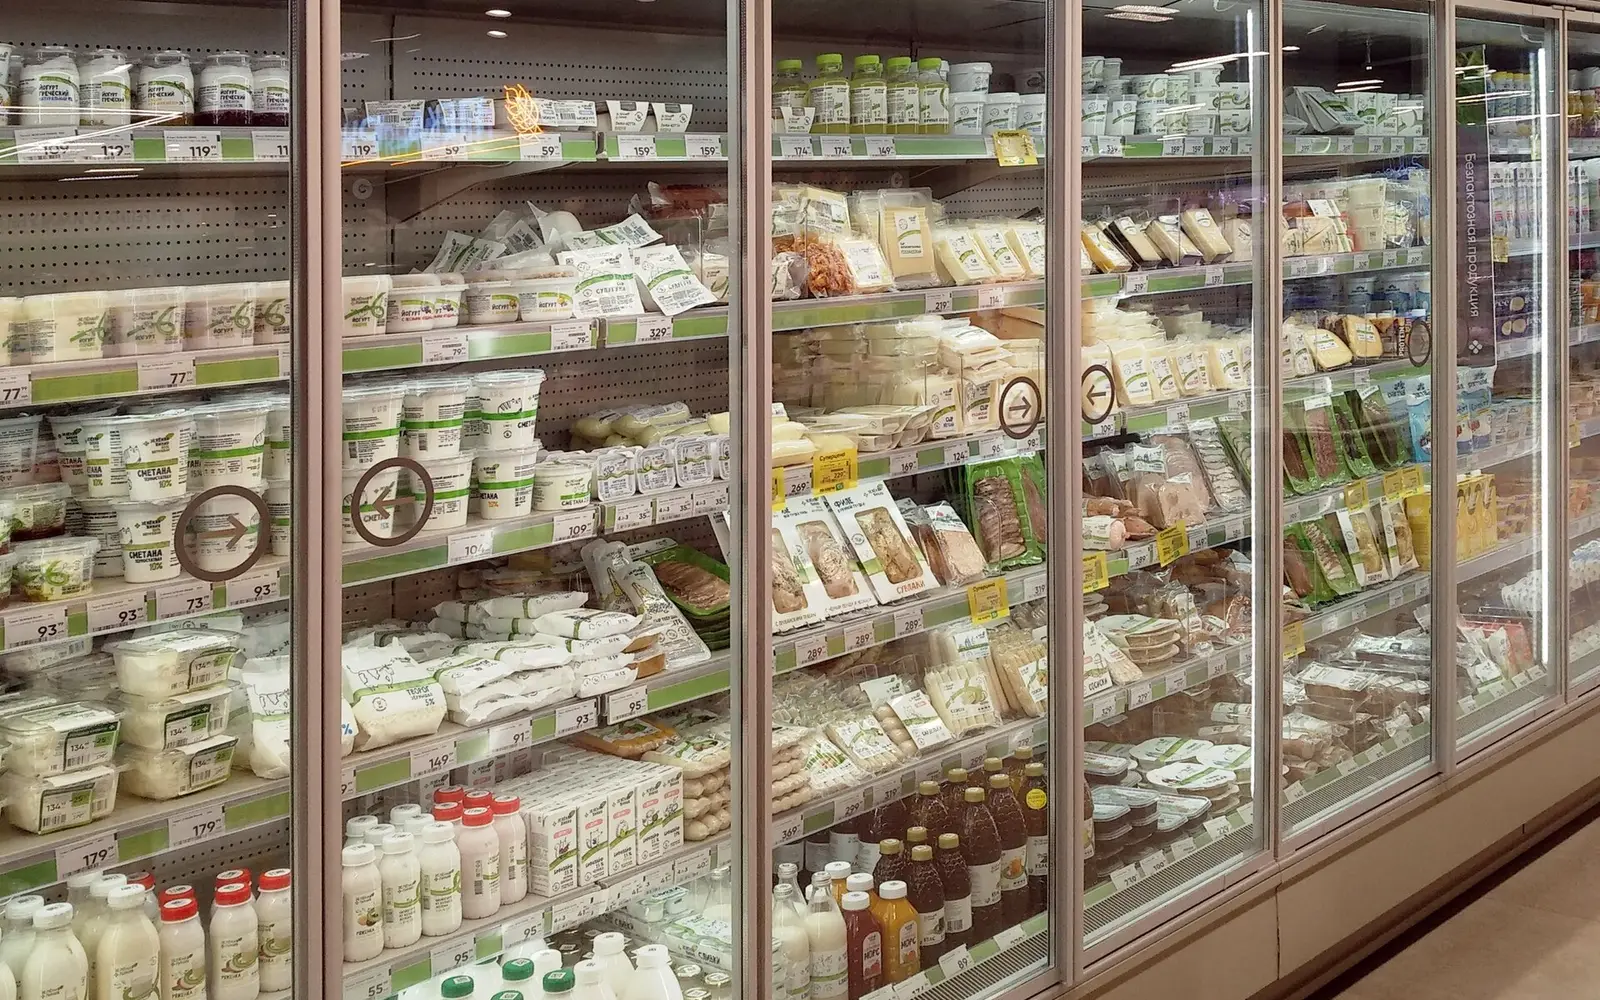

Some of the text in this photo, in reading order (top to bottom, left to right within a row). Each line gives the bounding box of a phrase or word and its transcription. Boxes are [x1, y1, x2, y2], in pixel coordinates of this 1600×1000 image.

[189, 146, 211, 157] 119
[352, 146, 371, 155] 119
[541, 146, 554, 156] 59
[634, 146, 650, 156] 159
[700, 146, 716, 156] 159
[1464, 153, 1479, 318] Безлактозная продукция
[650, 328, 667, 338] 329
[170, 372, 187, 384] 77
[2, 388, 21, 400] 77
[992, 444, 1001, 454] 96
[1027, 438, 1036, 448] 98
[952, 452, 965, 461] 124
[137, 466, 172, 478] СМЕТАНА
[901, 462, 914, 472] 169
[158, 480, 172, 489] 10%
[790, 483, 807, 494] 269
[834, 496, 854, 508] ФИЛЕ
[568, 524, 587, 536] 109
[129, 549, 162, 560] СМЕТАНА
[149, 562, 163, 571] 10%
[254, 584, 271, 598] 93
[186, 598, 204, 610] 73
[118, 610, 137, 622] 93
[37, 624, 58, 638] 93
[904, 620, 919, 631] 289
[856, 633, 870, 645] 289
[807, 646, 823, 658] 289
[406, 686, 430, 696] ТВОРОГ
[425, 698, 435, 706] 5%
[629, 702, 642, 712] 95
[576, 715, 589, 726] 93
[513, 732, 524, 744] 91
[429, 754, 449, 768] 149
[844, 804, 860, 817] 299
[192, 822, 216, 838] 179
[781, 828, 798, 840] 369
[82, 850, 108, 867] 179
[523, 925, 537, 938] 95
[900, 936, 917, 949] МОРС
[454, 951, 469, 965] 95
[864, 948, 880, 960] МОРС
[957, 957, 968, 970] 89
[368, 983, 384, 997] 55
